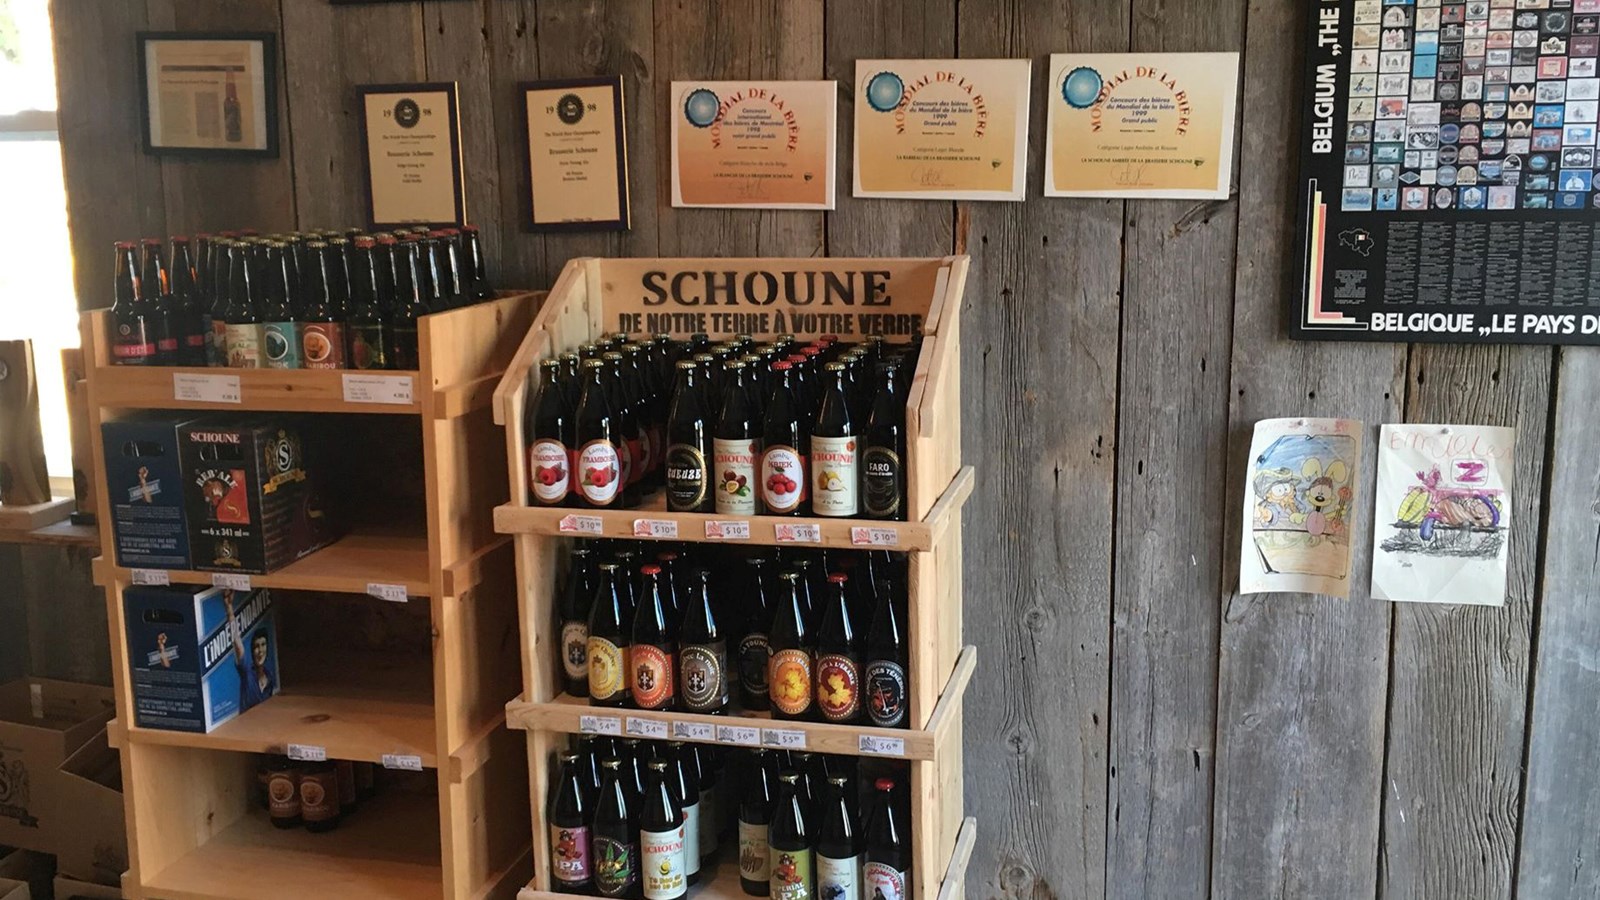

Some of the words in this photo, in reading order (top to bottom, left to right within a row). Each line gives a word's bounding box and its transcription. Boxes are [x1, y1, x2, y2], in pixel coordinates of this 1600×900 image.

[936, 71, 956, 83] DE
[958, 77, 974, 94] LA
[1136, 66, 1157, 79] DE
[1160, 72, 1176, 90] LA
[749, 87, 768, 100] DE
[769, 93, 785, 110] LA
[545, 106, 555, 114] 19
[587, 103, 597, 111] 98
[1312, 64, 1337, 153] BELGIUM
[641, 270, 892, 306] SCHOUNE
[618, 312, 642, 334] DE
[646, 312, 707, 334] NOTRE
[710, 312, 769, 334] TERRE
[791, 312, 852, 334] VOTRE
[857, 312, 922, 336] VERRE
[1371, 312, 1474, 332] BELGIQUE
[1522, 314, 1576, 335] PAYS
[1581, 315, 1600, 335] D
[190, 431, 240, 444] SCHOUNE
[583, 455, 615, 464] FRAMBOISE
[715, 454, 754, 464] CHOUNE
[811, 451, 854, 464] CHOUNE
[869, 462, 890, 472] FARO
[668, 468, 701, 480] GUEUZE
[221, 527, 233, 536] 341
